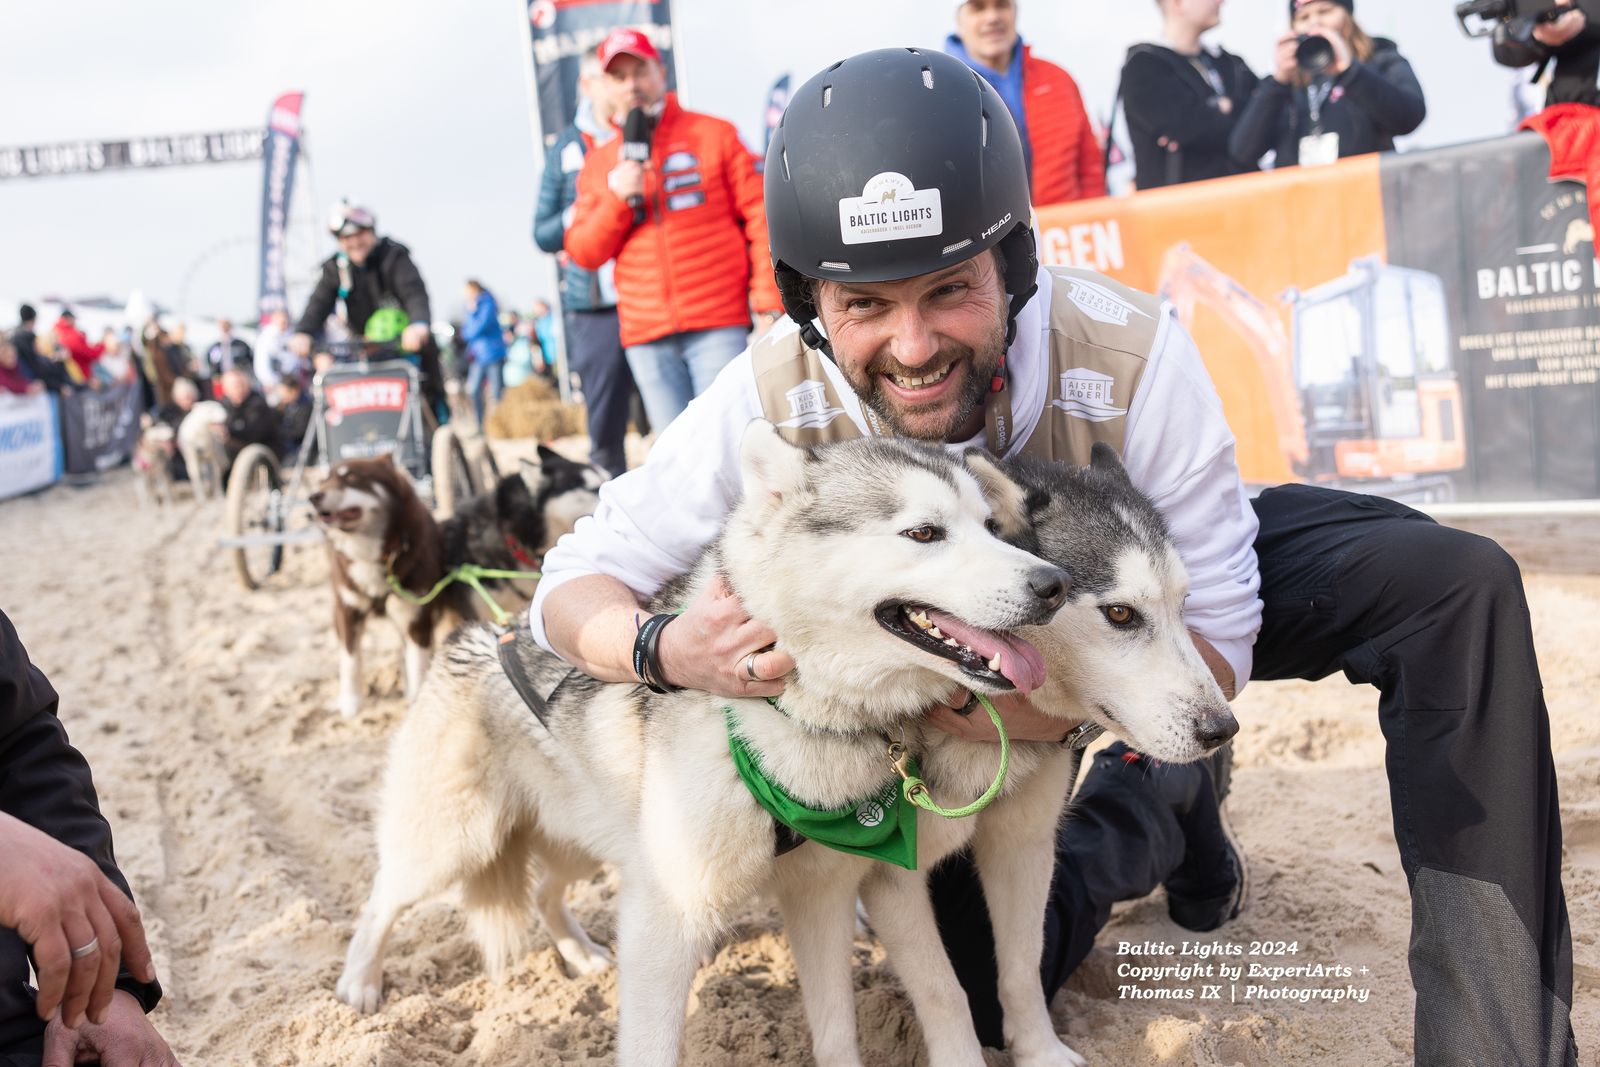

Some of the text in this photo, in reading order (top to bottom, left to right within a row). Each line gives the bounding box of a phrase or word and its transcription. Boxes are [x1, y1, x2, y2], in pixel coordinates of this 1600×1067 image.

[850, 207, 932, 227] BALTIC LIGHTS
[981, 212, 1012, 240] HEAD
[1043, 219, 1125, 271] GEN
[1477, 259, 1583, 299] BALTIC
[1068, 381, 1102, 391] AISER
